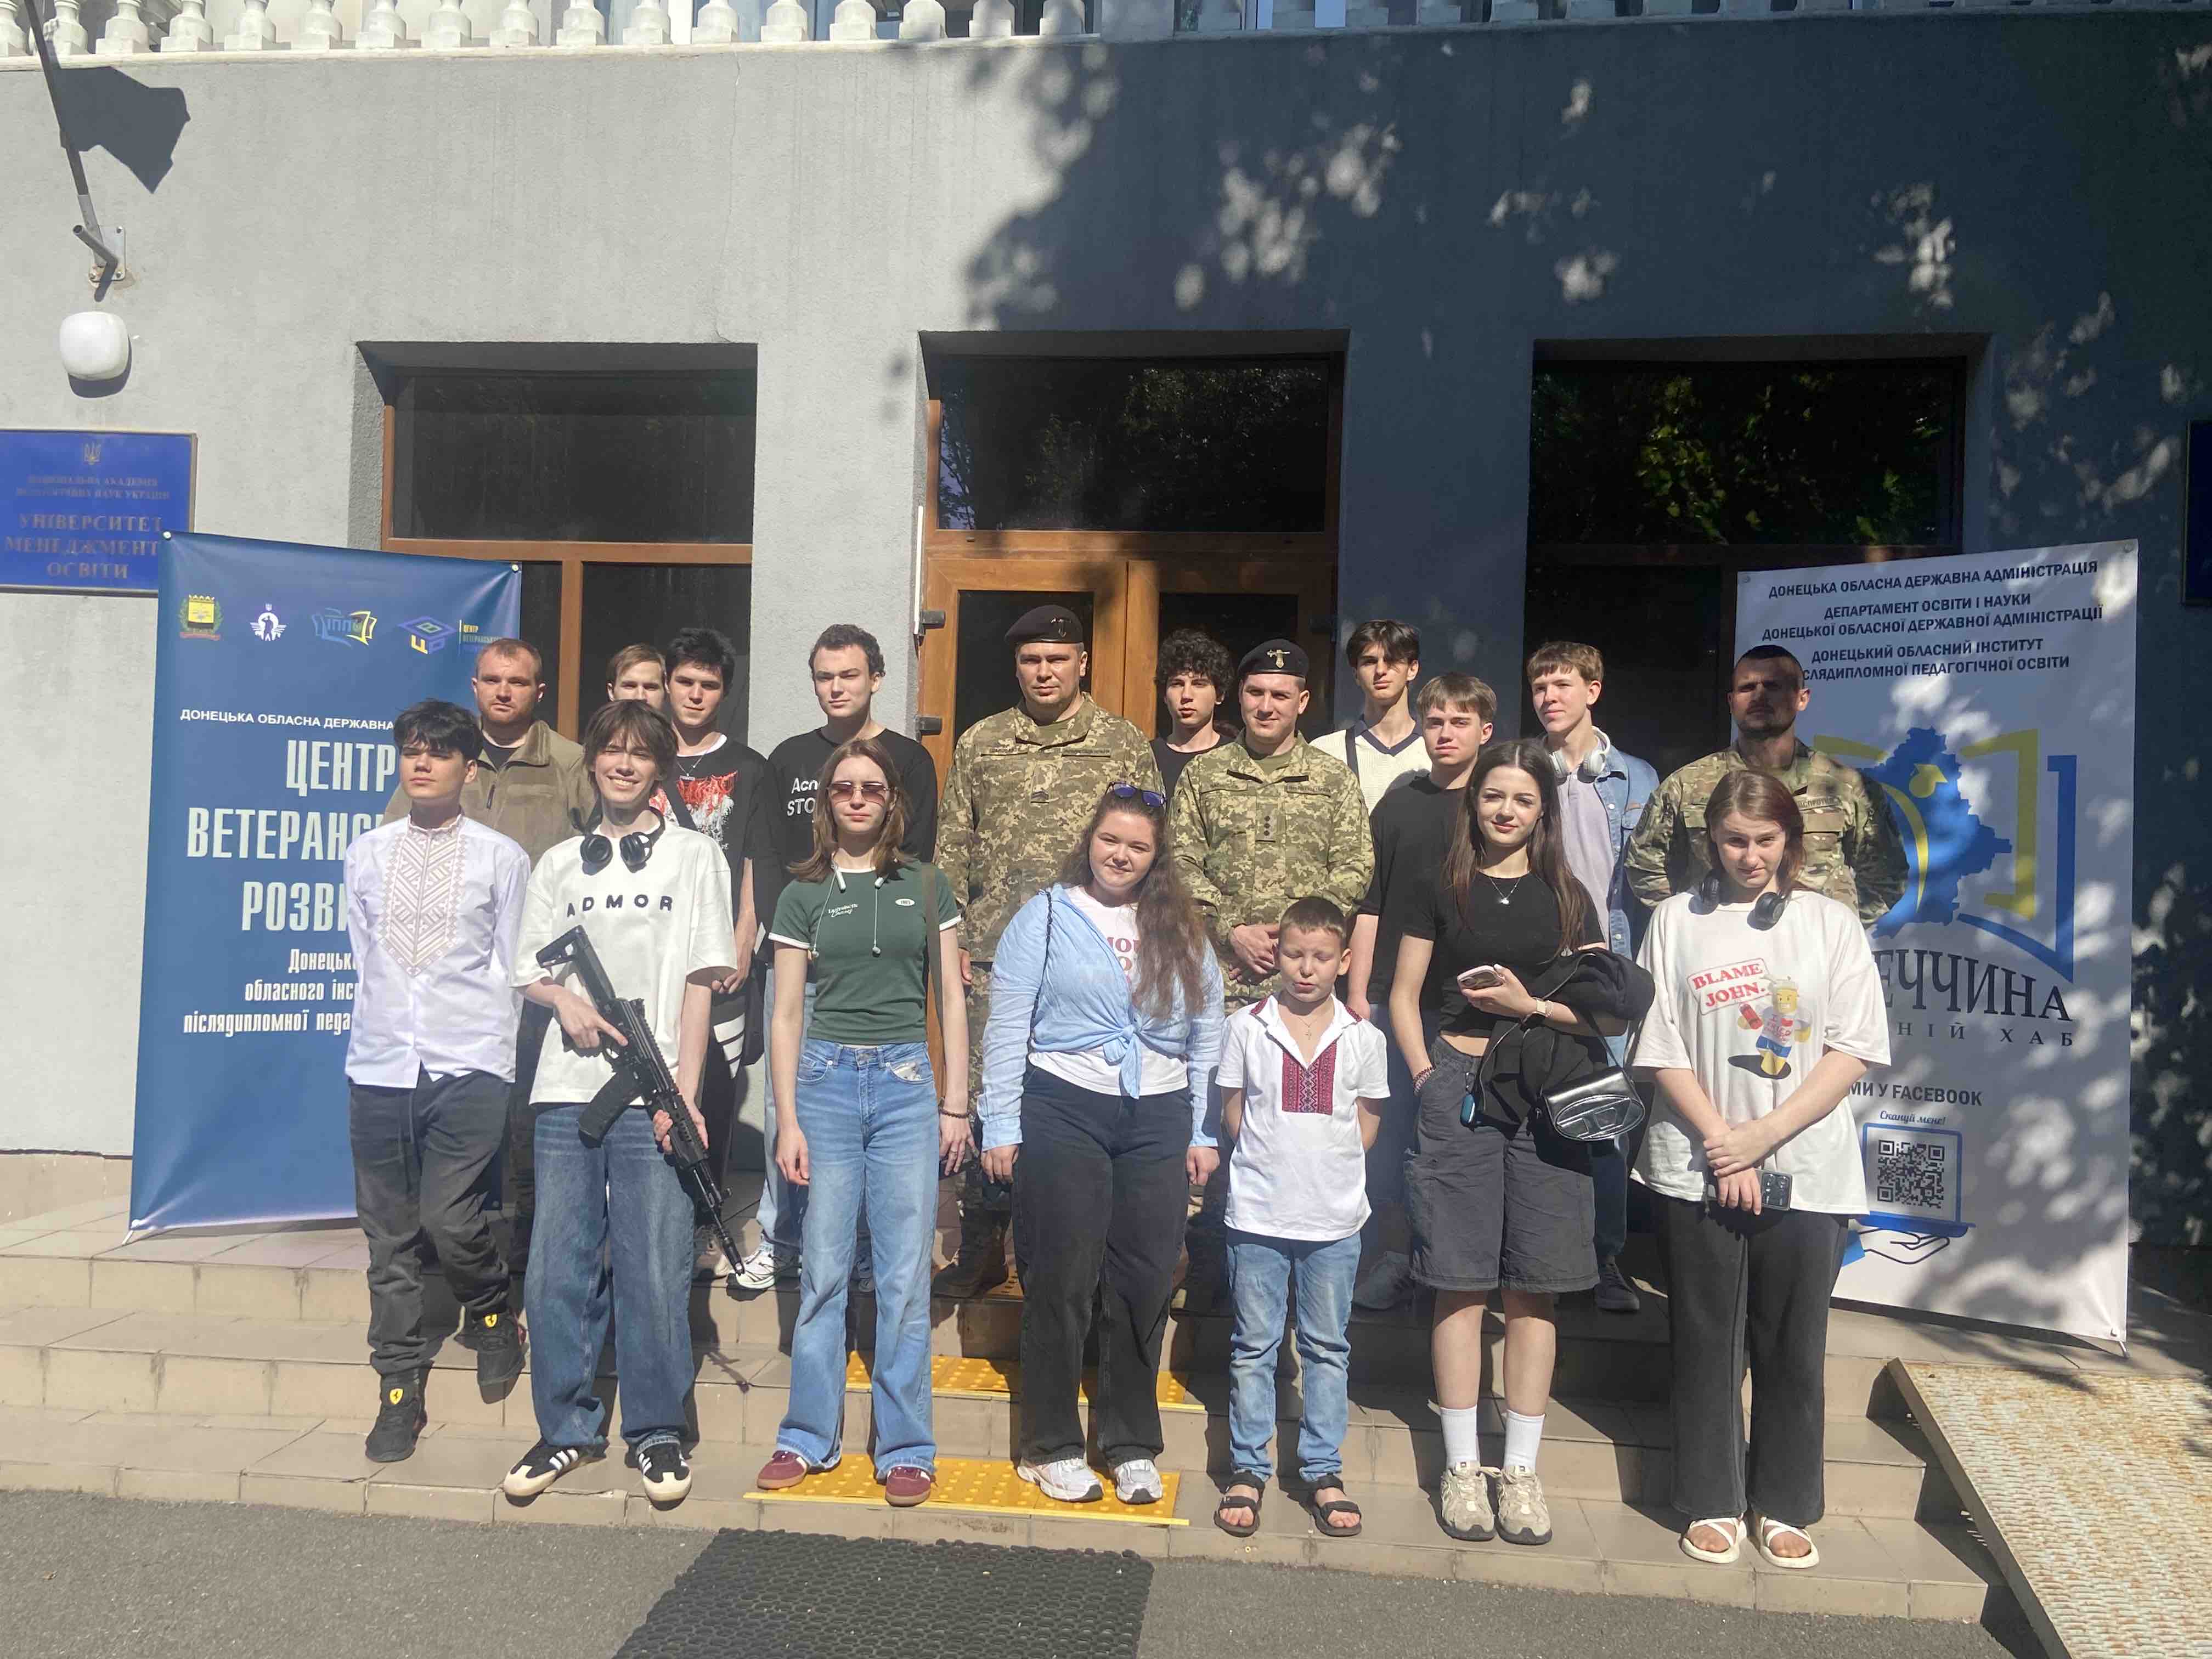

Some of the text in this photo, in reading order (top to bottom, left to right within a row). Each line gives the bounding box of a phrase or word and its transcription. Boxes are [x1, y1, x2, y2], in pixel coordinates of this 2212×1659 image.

[19, 514, 162, 532] УНІВЕРСИТЕТ
[6, 536, 158, 556] МЕНЕДЖМЕНТ
[47, 562, 128, 579] ОСВІТИ
[1769, 560, 2098, 599] ДОНЕЦЬКА ОБЛАСНА ДЕРЖАВНА АДМІНІСТРАЦІЯ
[1824, 593, 2031, 620] ДЕПАРТАМЕНТ ОСВІТИ І НАУКИ
[1762, 605, 2103, 641] ДОНЕЦЬКОЇ ОБЛАСНОЇ ДЕРЖАВНОЇ АДМІНІСТРАЦІЇ
[1812, 638, 2044, 664] ДОНЕЦЬКИЙ ОБЛАСНИЙ ІНСТИТУТ
[1803, 656, 2069, 681] СЛЯДИПЛОМНОЇ ПЕДАГОГІЧНОЇ ОСВІТИ
[180, 709, 394, 730] ДОНЕЦЬКА ОБЛАСНА ДЕРЖАВНА
[286, 740, 396, 797] ЦЕНТР
[791, 777, 820, 794] Acn
[787, 797, 816, 816] STO
[187, 807, 383, 861] ВЕТЕРАНС
[567, 894, 673, 918] ADMOR
[1692, 963, 1763, 989] BLAME
[1871, 949, 2072, 1023] ЕЧЧИНА
[245, 979, 325, 1001] обласного
[1706, 982, 1765, 1007] JOHN.
[184, 1009, 351, 1037] післядипломної педа
[1897, 1021, 2073, 1046] НІЙ ХАБ
[1848, 1081, 1874, 1097] МИ
[1893, 1084, 1983, 1106] FACEBOOK
[1880, 1110, 1915, 1124] Скануй
